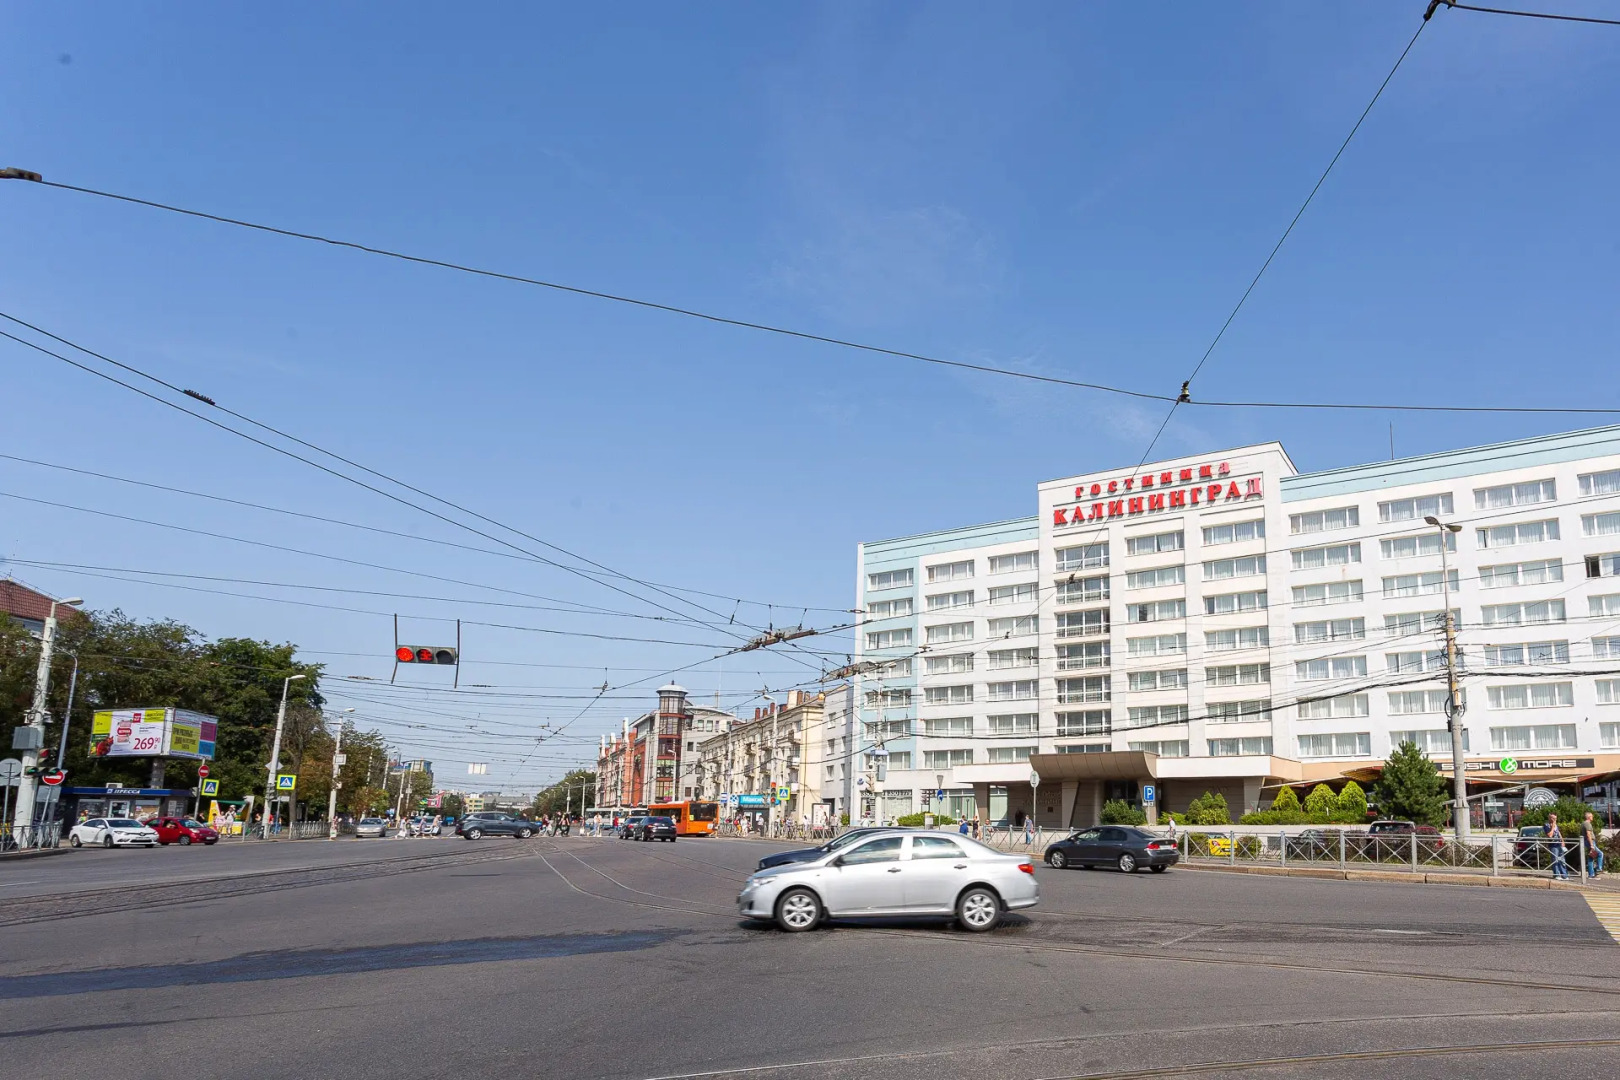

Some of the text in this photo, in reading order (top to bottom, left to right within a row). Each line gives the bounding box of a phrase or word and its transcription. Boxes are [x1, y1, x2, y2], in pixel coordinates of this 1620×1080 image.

[1054, 477, 1262, 525] КАЛИНИНГРАД
[134, 737, 154, 750] 269
[1441, 762, 1495, 771] SSHI
[1522, 759, 1577, 769] MORE
